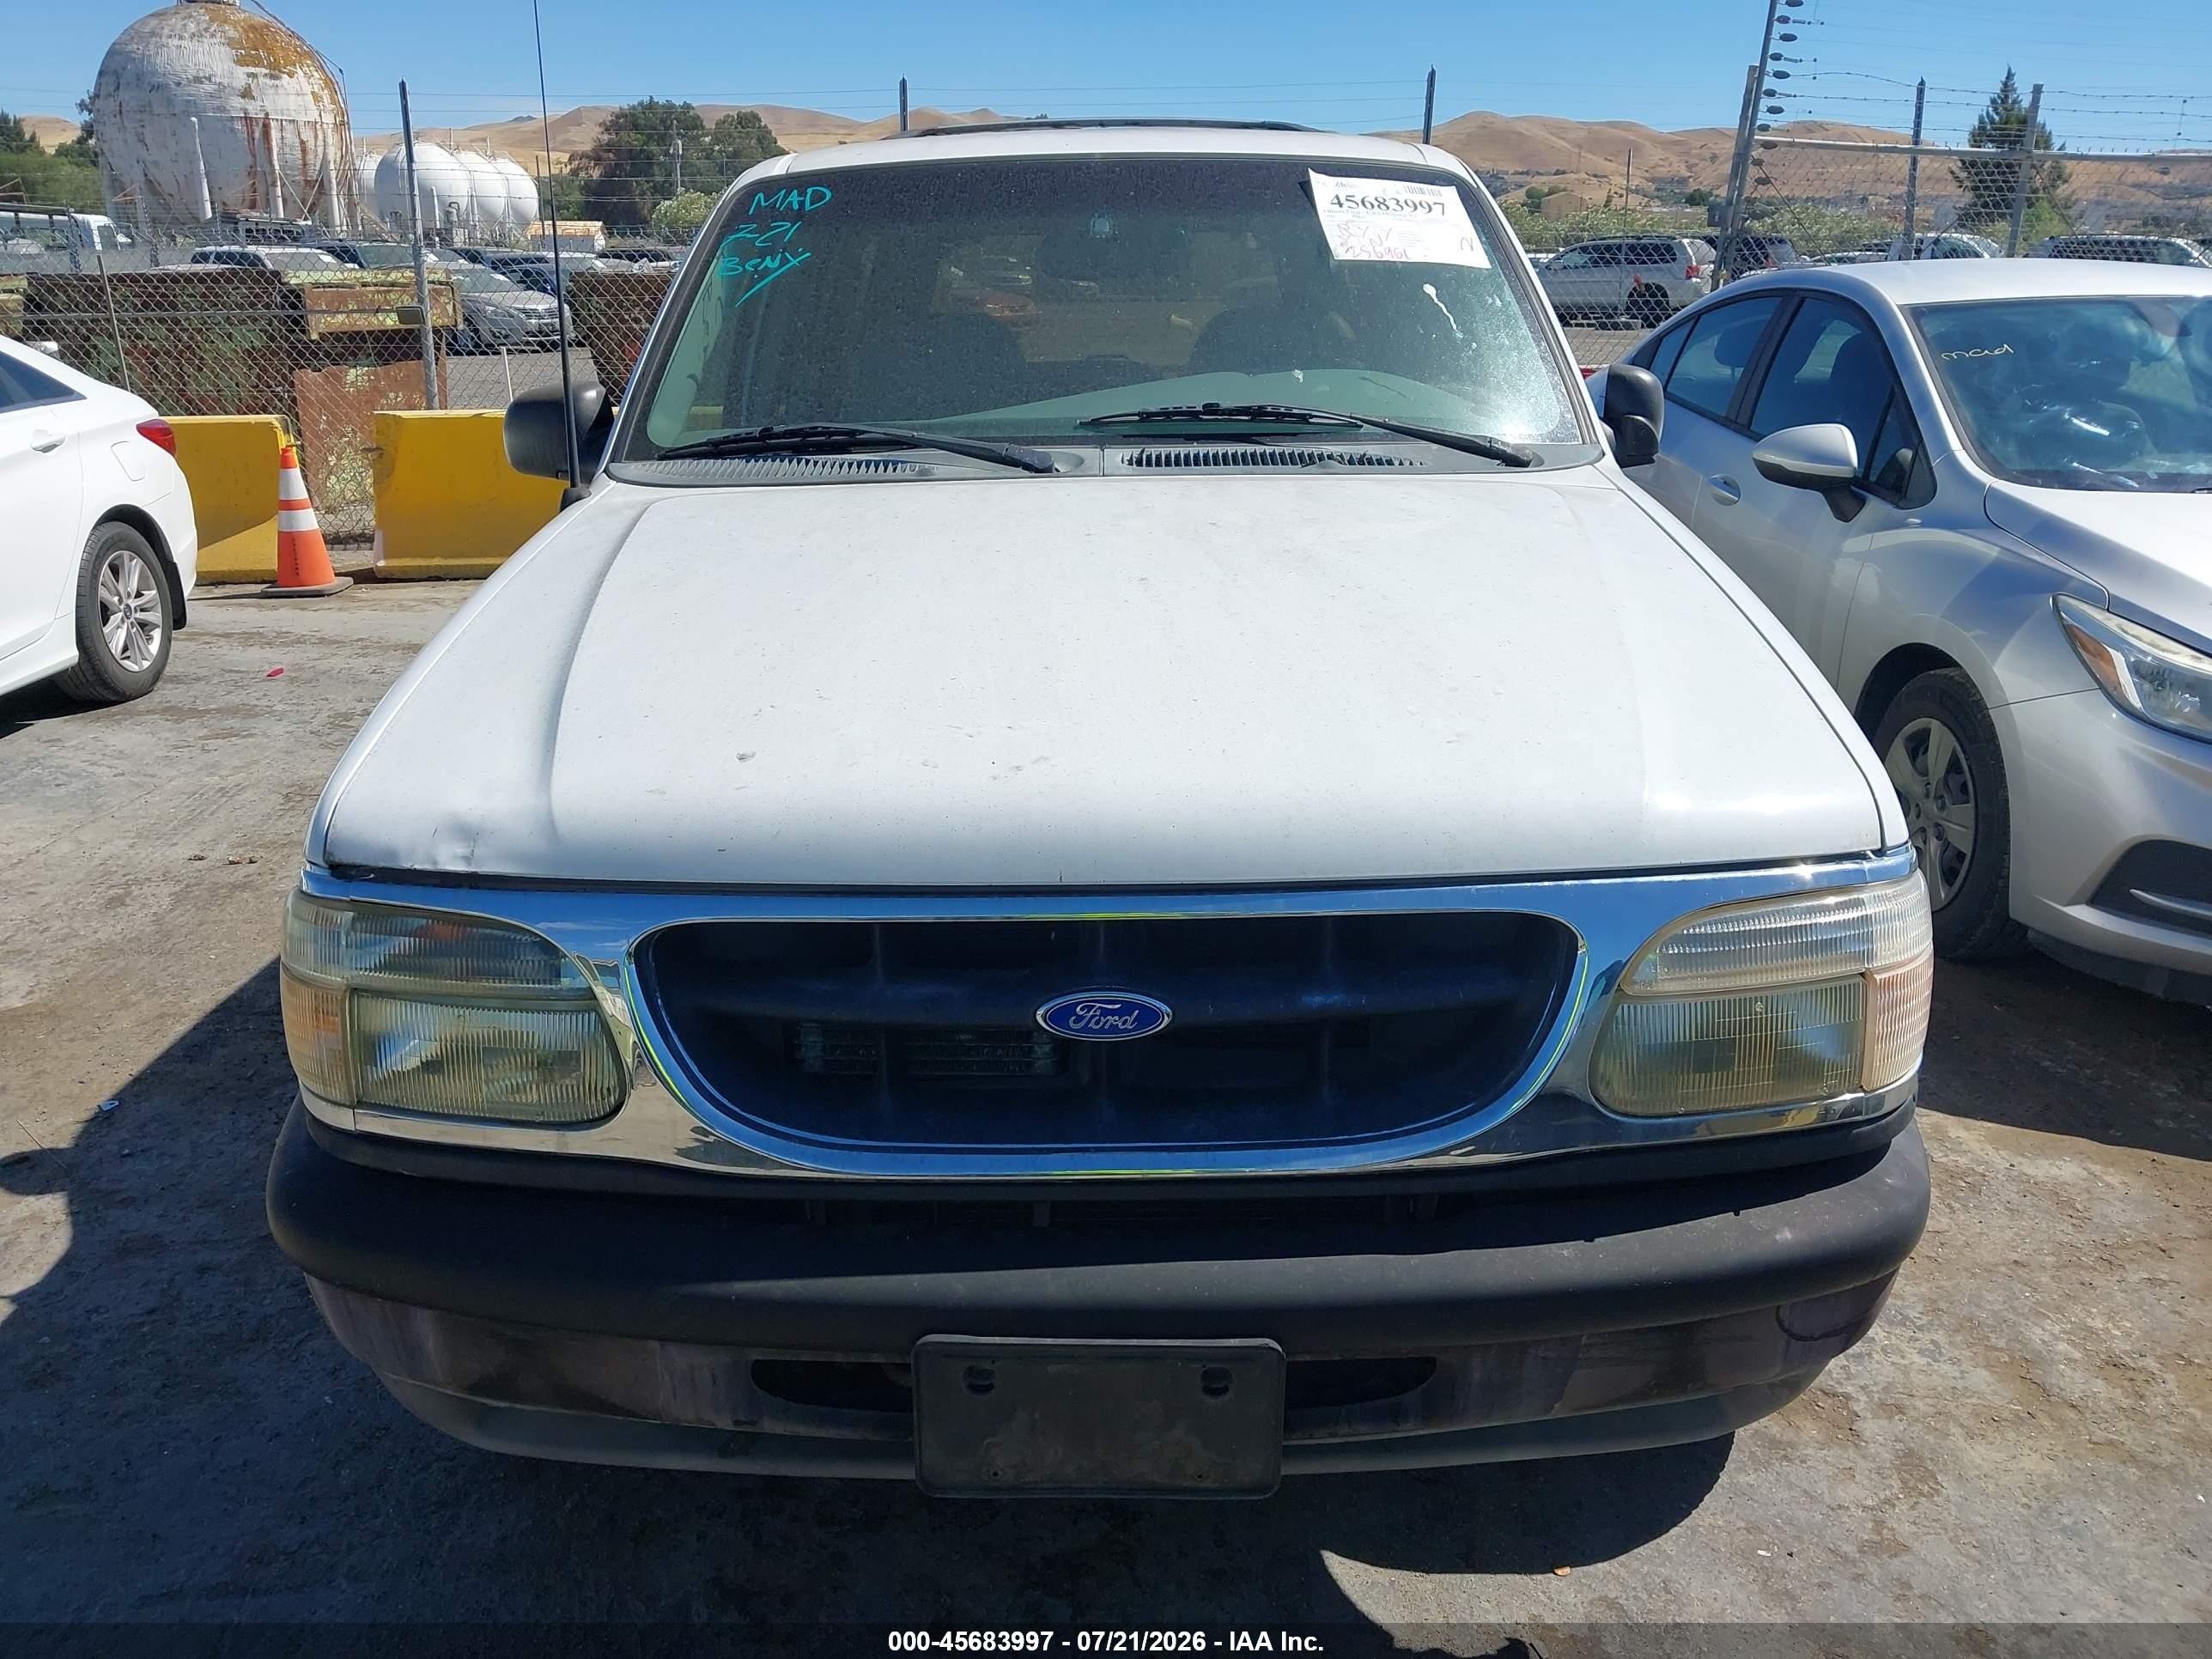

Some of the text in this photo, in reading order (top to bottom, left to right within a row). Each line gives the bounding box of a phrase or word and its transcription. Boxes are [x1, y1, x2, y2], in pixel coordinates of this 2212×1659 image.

[748, 185, 832, 215] MAD
[1330, 193, 1445, 216] 45683997
[1941, 343, 2015, 362] mad
[1068, 1002, 1139, 1030] Ford
